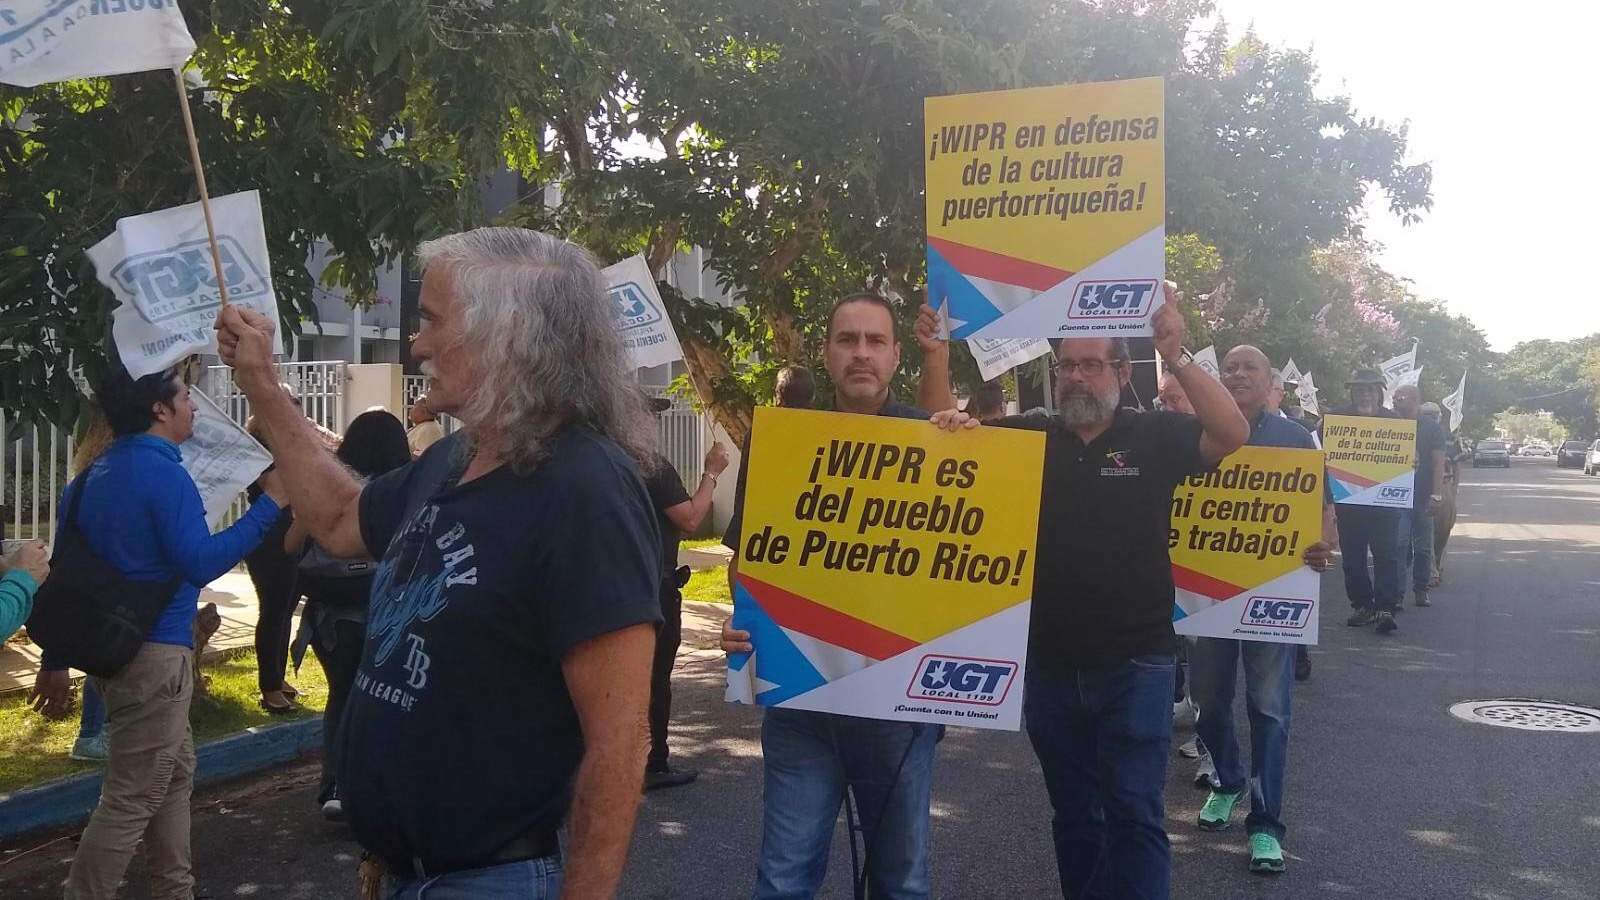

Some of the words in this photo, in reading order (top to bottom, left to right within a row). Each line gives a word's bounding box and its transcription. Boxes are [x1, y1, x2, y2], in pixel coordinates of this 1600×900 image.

[930, 121, 1007, 161] ¡WIPR
[1015, 125, 1046, 149] en
[1054, 114, 1160, 147] defensa
[962, 158, 991, 186] de
[999, 156, 1022, 184] la
[1030, 151, 1124, 181] cultura
[941, 181, 1147, 227] puertorriqueña!
[1079, 284, 1153, 309] UGT
[1058, 323, 1090, 332] ¡Cuenta
[1108, 323, 1117, 331] tu
[1119, 322, 1146, 330] Unión!
[1325, 425, 1357, 438] ¡WIPR
[1360, 429, 1372, 438] en
[1375, 428, 1415, 441] defensa
[1337, 439, 1351, 449] de
[1353, 439, 1362, 449] la
[1365, 440, 1401, 452] cultura
[808, 440, 926, 484] ¡WIPR
[935, 457, 979, 489] es
[1180, 464, 1318, 494] endiendo
[1381, 487, 1409, 498] UGT
[795, 484, 854, 524] del
[857, 496, 984, 535] pueblo
[1200, 497, 1290, 524] centro
[436, 521, 478, 588] BAY
[745, 526, 791, 565] de
[799, 530, 920, 577] Puerto
[929, 542, 1028, 586] Rico!
[1168, 528, 1180, 548] e
[1188, 524, 1299, 560] trabajo!
[1250, 600, 1310, 620] UGT
[402, 633, 431, 689] TB
[921, 660, 1011, 693] UGT
[369, 679, 418, 711] LEAGUE
[922, 689, 960, 699] LOCAL
[966, 694, 994, 702] 1199
[894, 704, 932, 714] ¡Cuenta
[934, 708, 953, 716] con
[954, 709, 965, 717] tu
[967, 710, 999, 720] Unión!
